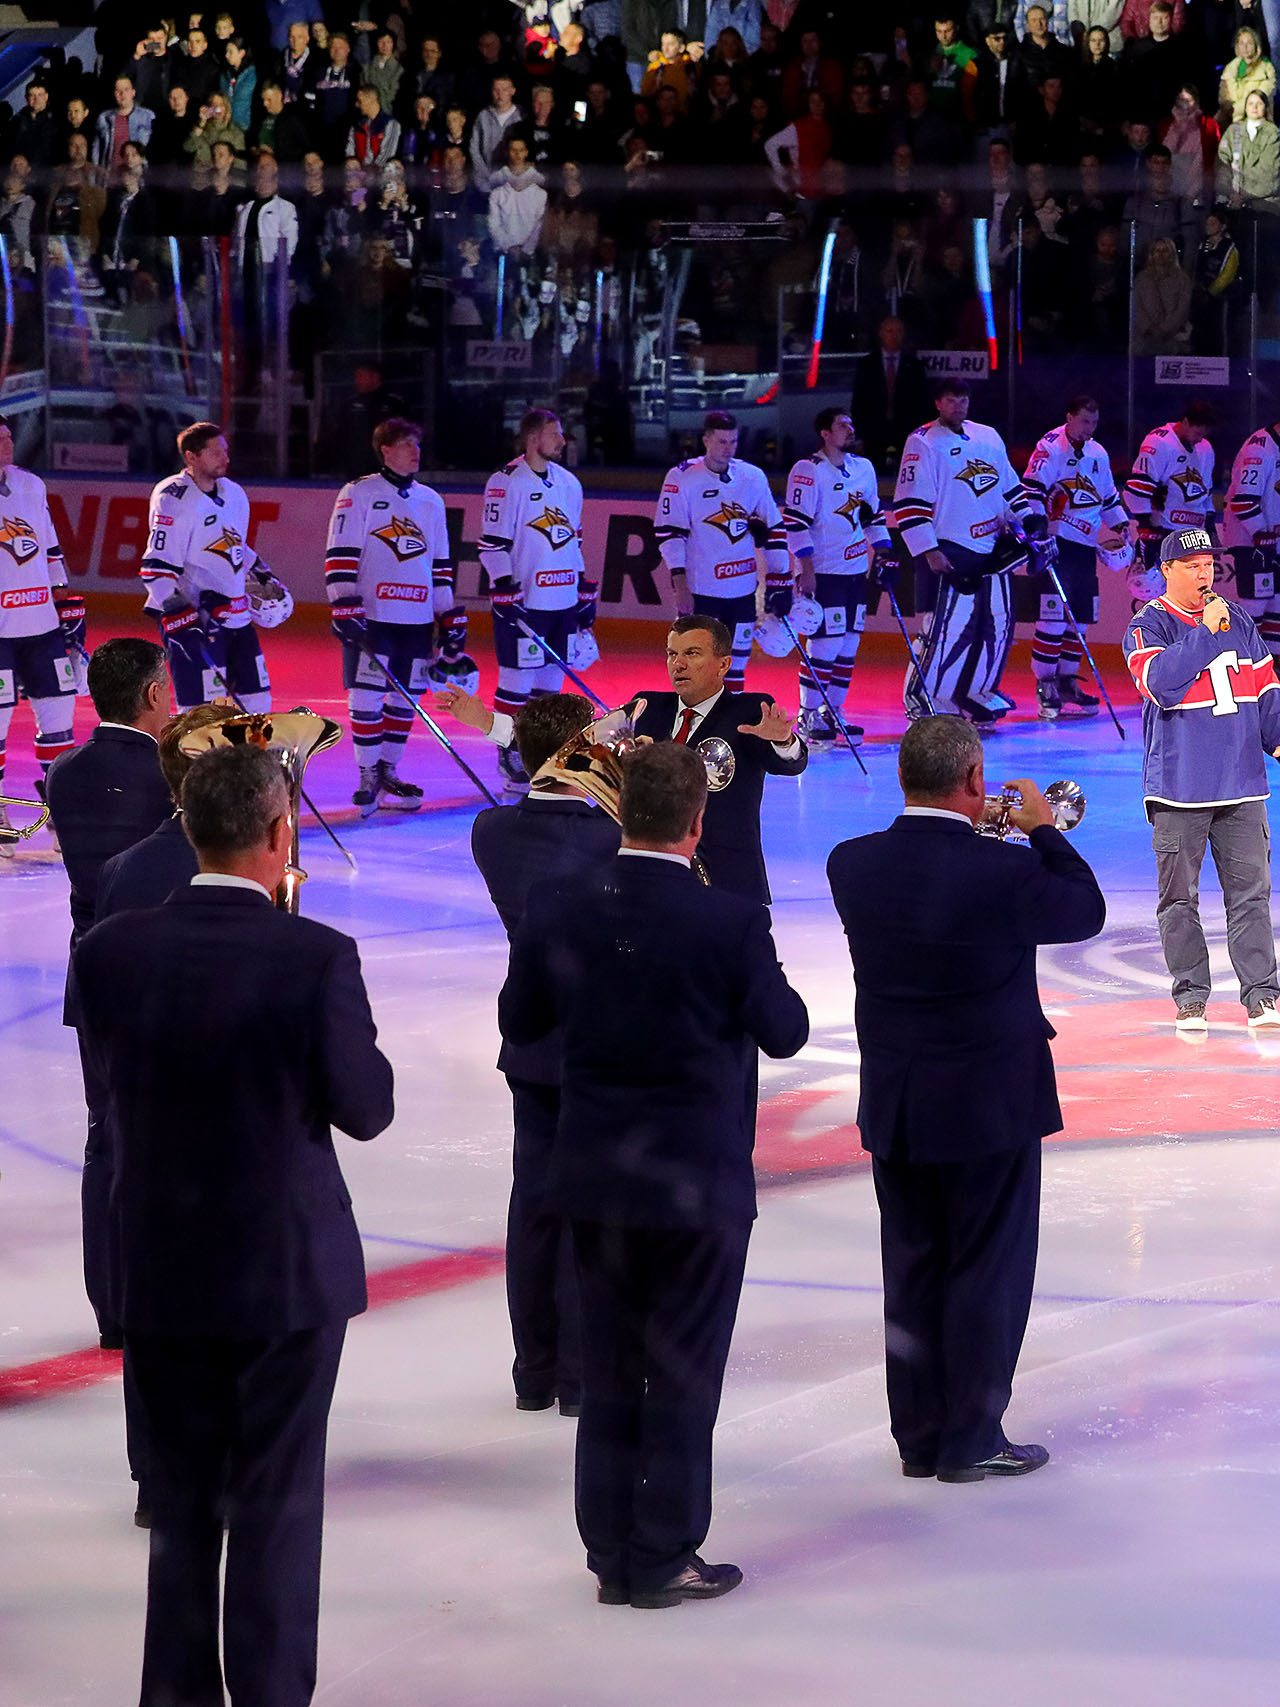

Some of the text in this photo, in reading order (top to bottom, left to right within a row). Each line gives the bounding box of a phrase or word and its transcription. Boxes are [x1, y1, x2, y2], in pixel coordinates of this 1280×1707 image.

[1092, 459, 1099, 474] A
[1240, 469, 1259, 486] 22
[792, 487, 802, 506] 8
[662, 497, 671, 515] 9
[537, 572, 575, 585] FONBET
[2, 589, 48, 607] FONBET
[378, 585, 428, 601] FONBET
[1195, 649, 1240, 717] T
